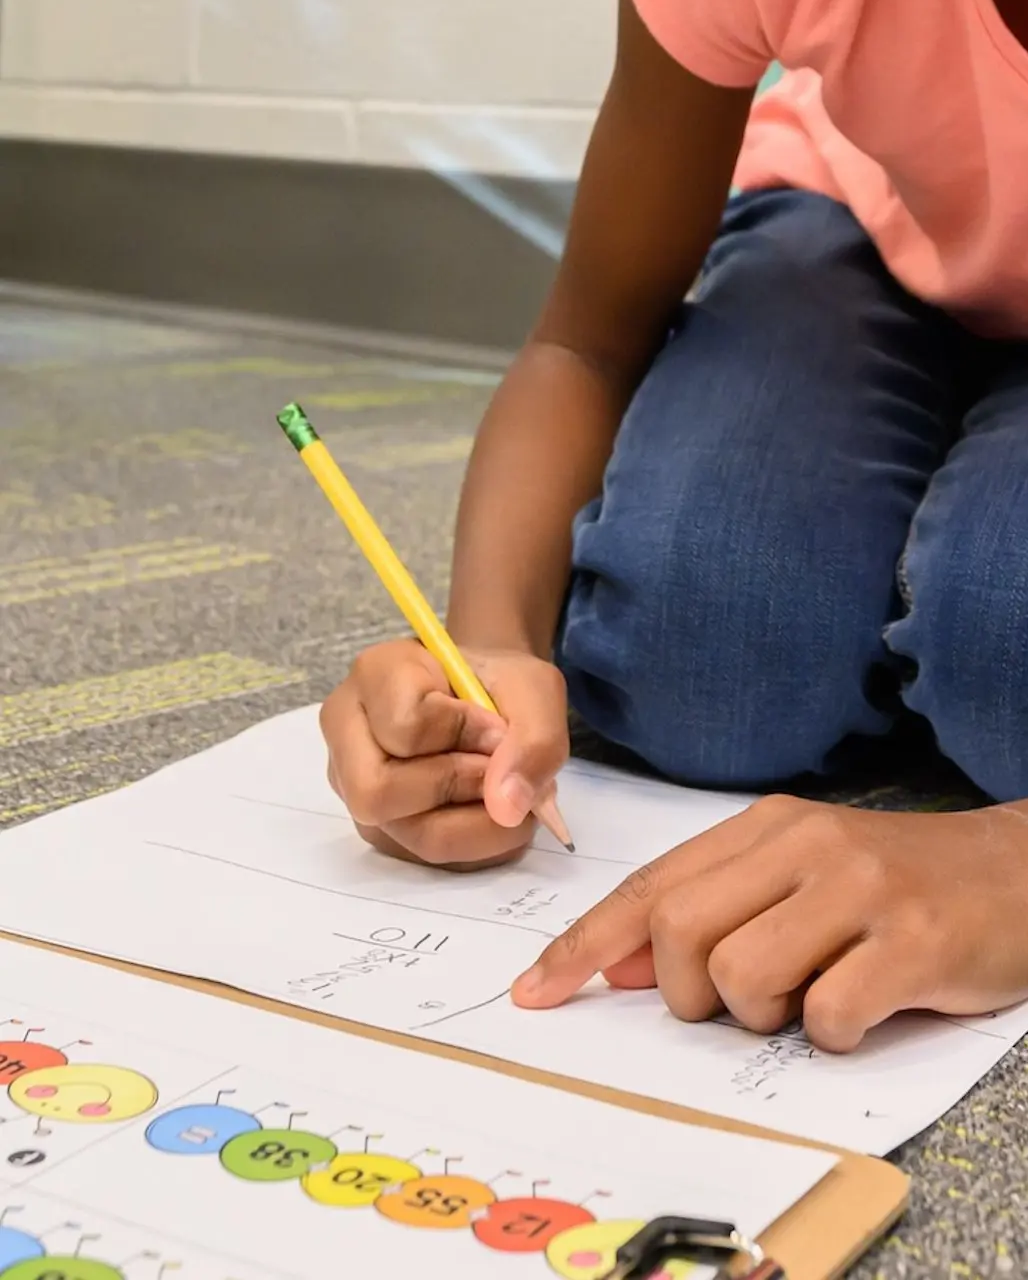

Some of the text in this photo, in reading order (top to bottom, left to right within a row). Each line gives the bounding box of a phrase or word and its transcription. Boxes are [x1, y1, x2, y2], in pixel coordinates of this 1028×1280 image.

[248, 1140, 553, 1240] 12 55 20 38
